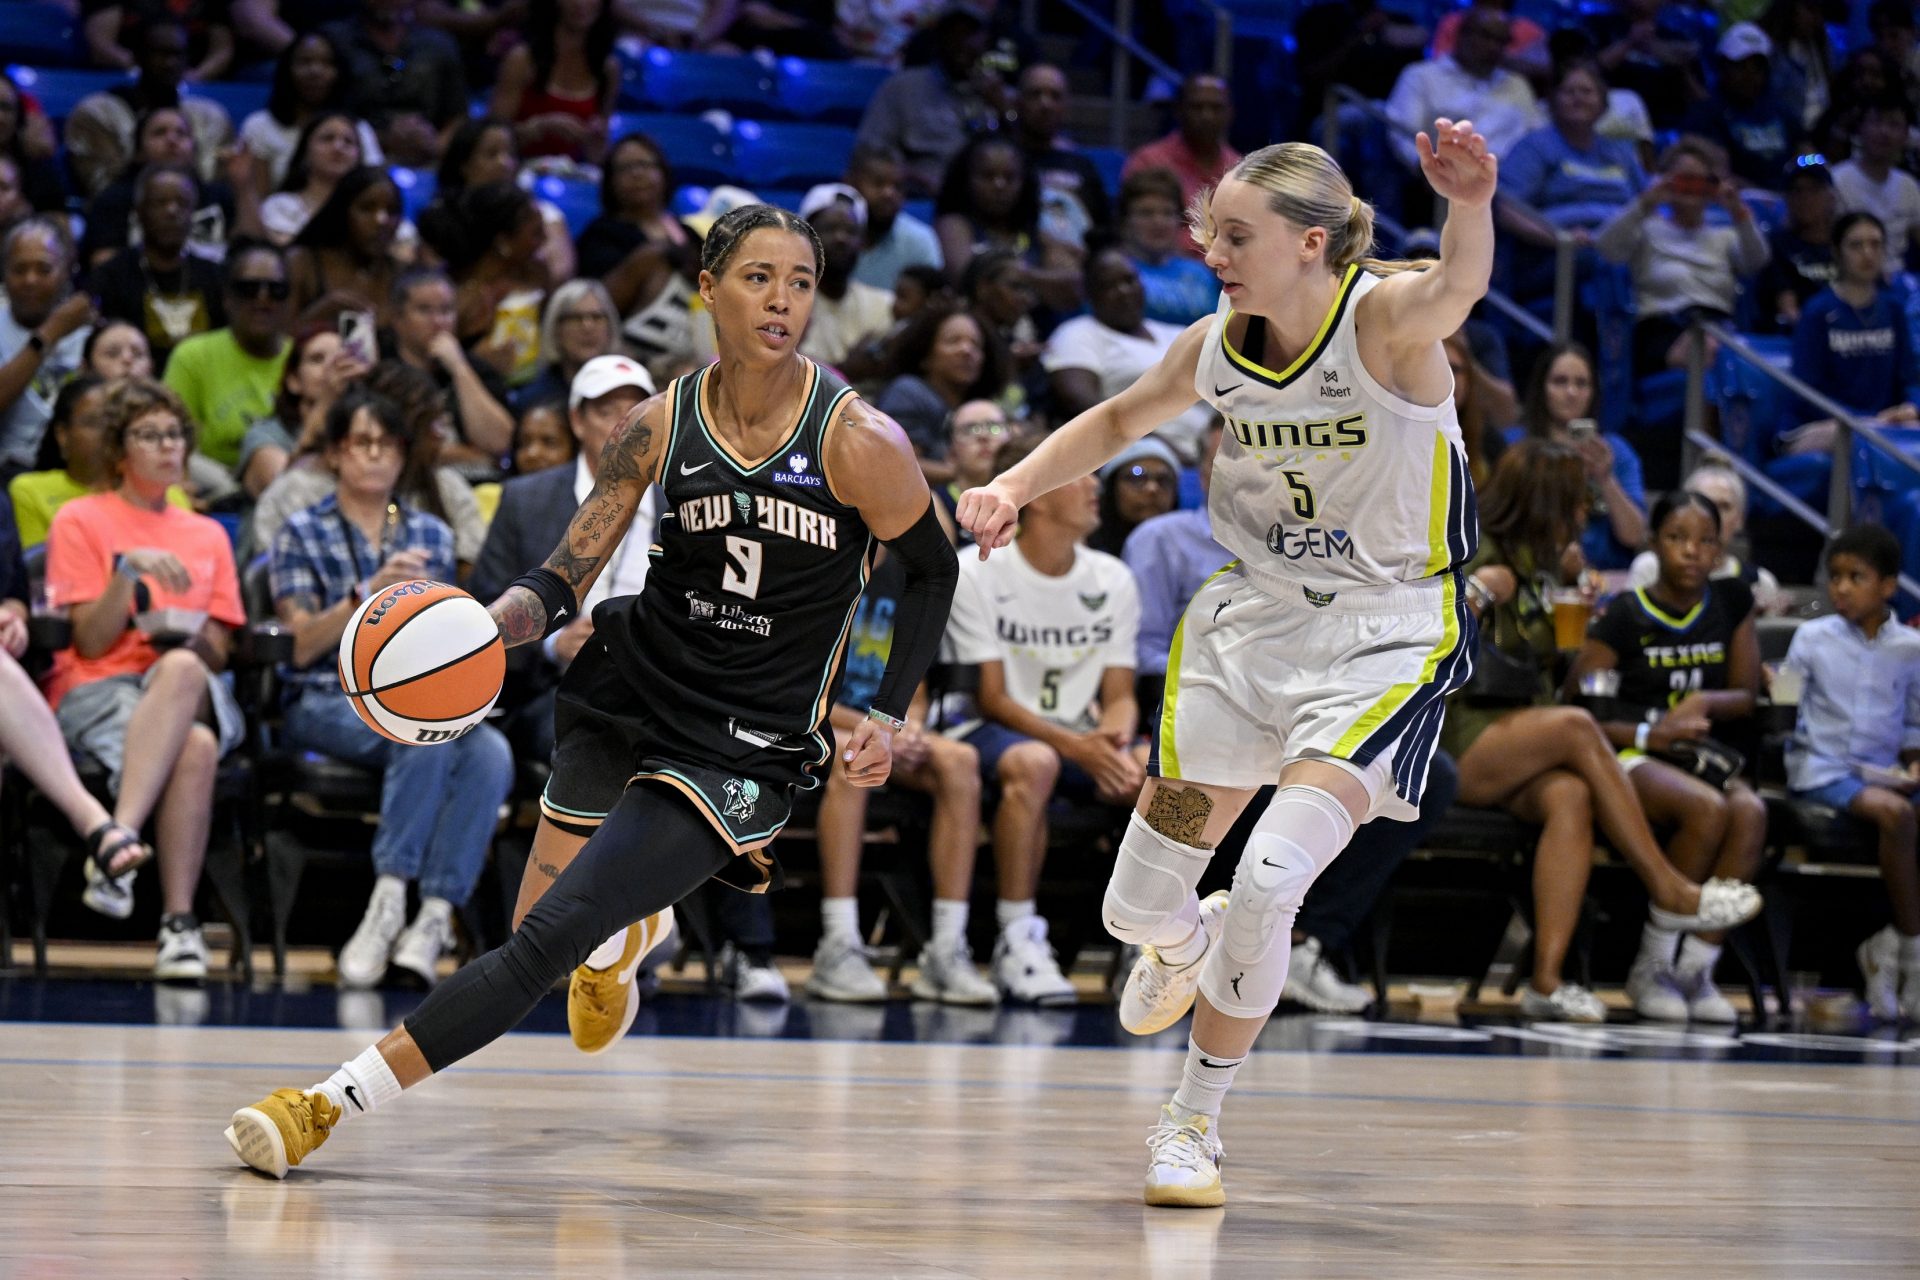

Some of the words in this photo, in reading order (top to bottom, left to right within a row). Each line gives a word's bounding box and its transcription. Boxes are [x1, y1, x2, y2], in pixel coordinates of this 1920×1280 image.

[1320, 386, 1351, 398] Albert
[774, 473, 821, 486] BARCLAYS
[1281, 470, 1317, 524] 5
[679, 494, 732, 534] NEW
[755, 495, 837, 551] YORK
[1283, 528, 1354, 560] GEM
[721, 535, 763, 601] 9
[997, 616, 1114, 646] WINGS
[1644, 642, 1725, 668] TEXAS
[1040, 668, 1063, 711] 5
